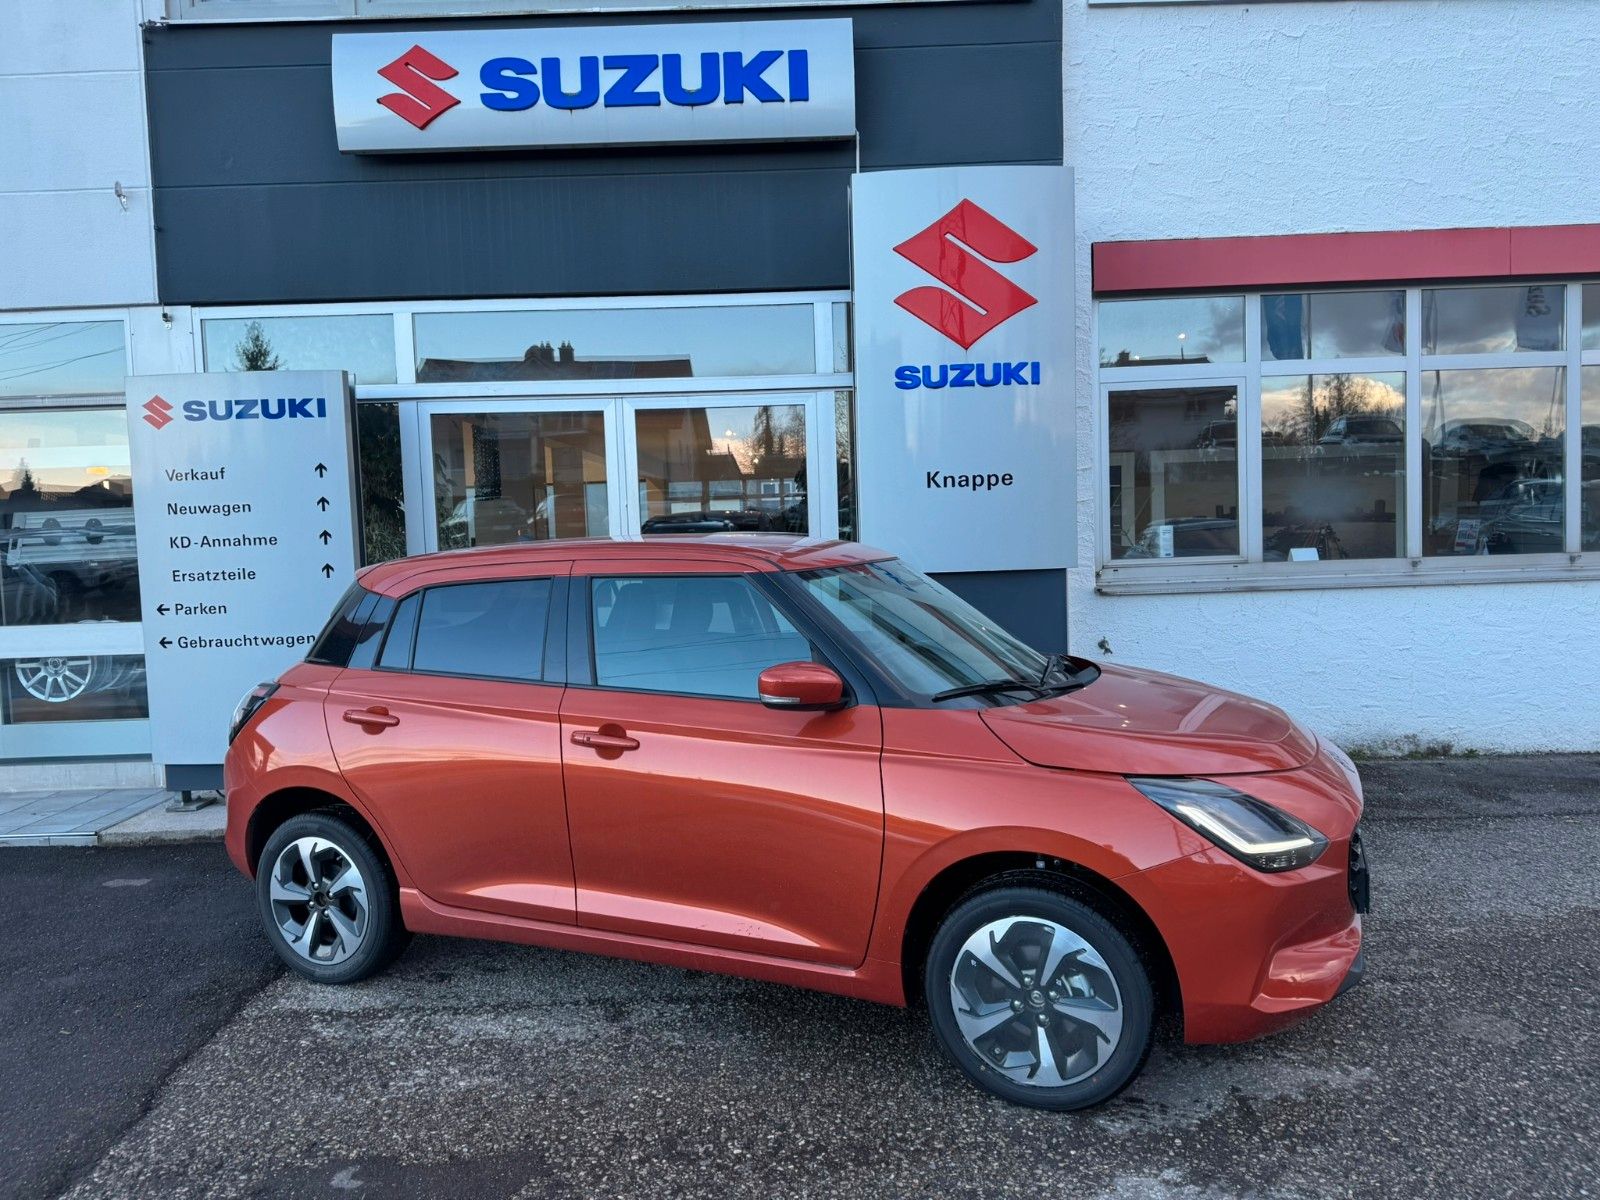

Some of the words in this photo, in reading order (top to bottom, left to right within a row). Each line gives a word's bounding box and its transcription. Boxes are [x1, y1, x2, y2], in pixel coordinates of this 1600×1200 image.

[479, 49, 809, 111] SUZUKI
[894, 361, 1040, 390] SUZUKI
[183, 398, 326, 421] SUZUKI
[165, 466, 226, 482] Verkauf
[926, 471, 1014, 492] Knappe
[167, 502, 252, 517] Neuwagen
[169, 534, 278, 549] KD-Annahme
[172, 567, 257, 583] Ersatzteile
[174, 601, 228, 617] Parken
[177, 633, 316, 650] Gebrauchtwagen
